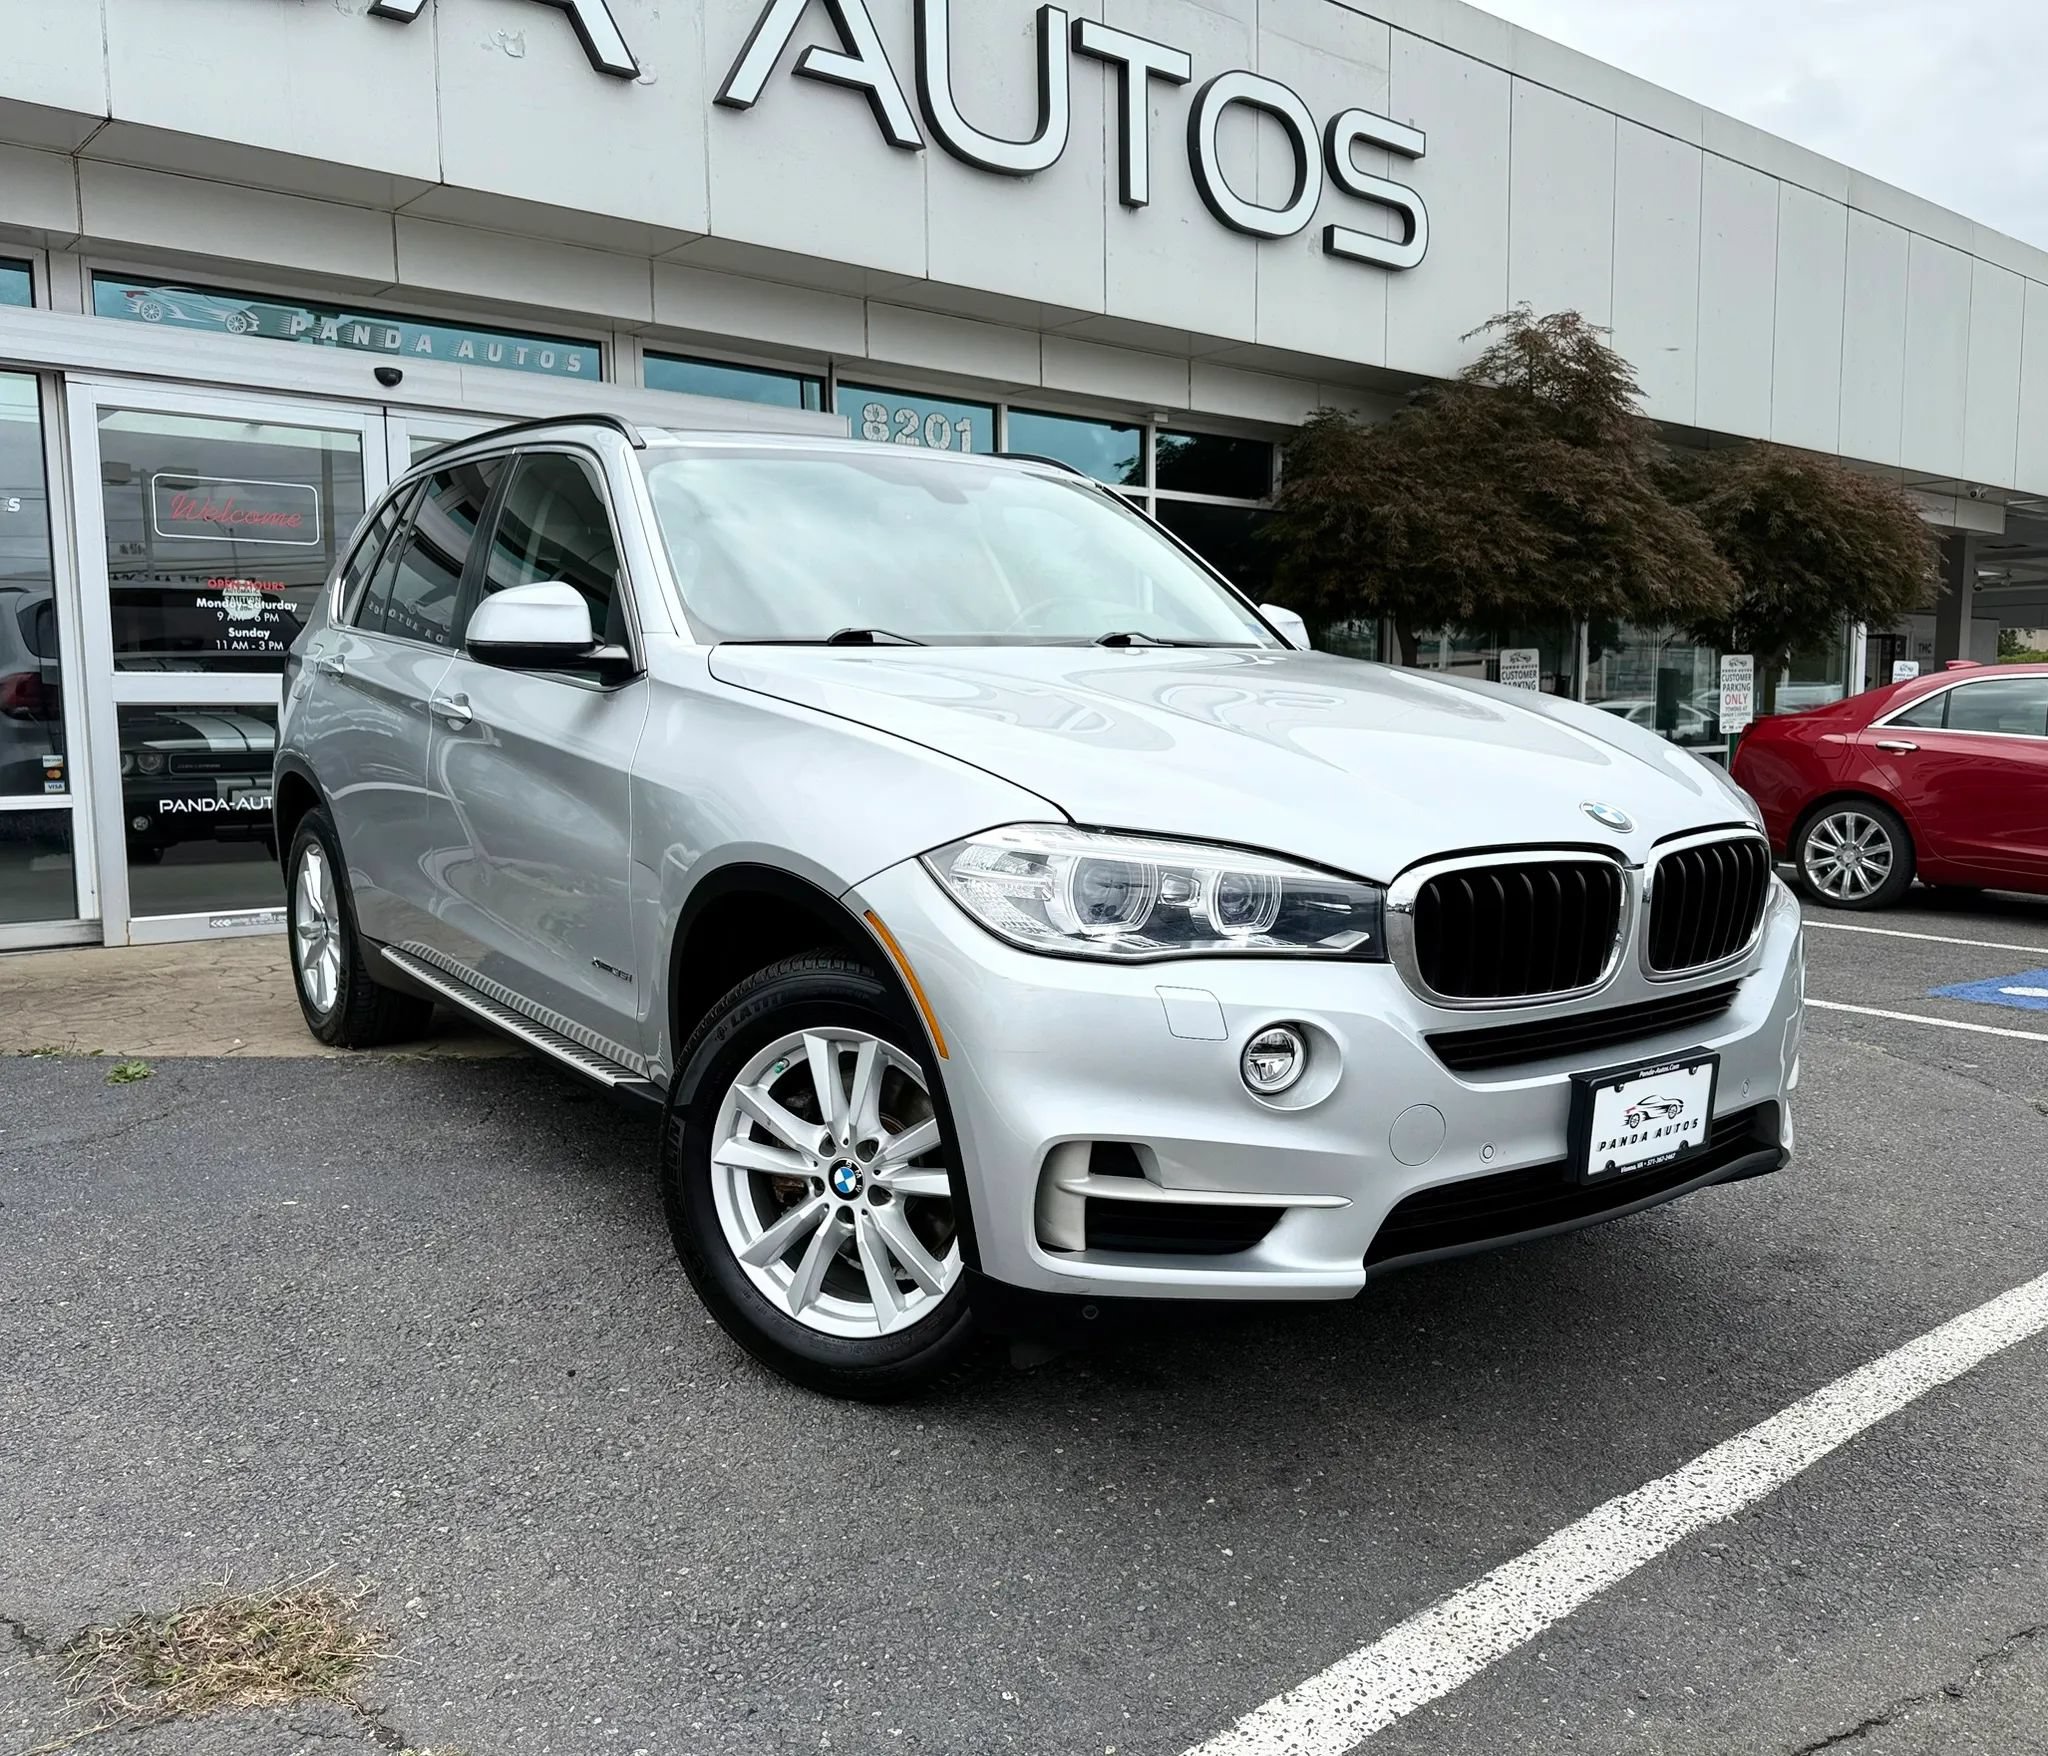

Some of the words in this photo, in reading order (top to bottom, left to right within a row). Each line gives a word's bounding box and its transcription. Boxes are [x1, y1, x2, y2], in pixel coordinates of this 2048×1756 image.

[713, 0, 1429, 271] AUTOS
[286, 314, 433, 353] PANDA
[456, 339, 583, 373] AUTOS
[862, 402, 972, 453] 8201
[171, 492, 303, 529] Welcome
[245, 580, 286, 592] HOURS
[196, 598, 298, 612] Monday-Saturday
[217, 611, 224, 621] 9
[264, 612, 280, 622] PM
[228, 627, 271, 640] Sunday
[216, 640, 228, 650] 11
[232, 640, 249, 650] AM
[259, 640, 266, 651] 3
[269, 640, 284, 651] PM
[1501, 670, 1538, 681] CUSTOMER
[1721, 673, 1752, 682] CUSTOMER
[1722, 682, 1752, 692] PARKING
[1724, 693, 1748, 706] ONLY
[1598, 1131, 1649, 1152] PANDA
[1655, 1118, 1699, 1139] AUTOS
